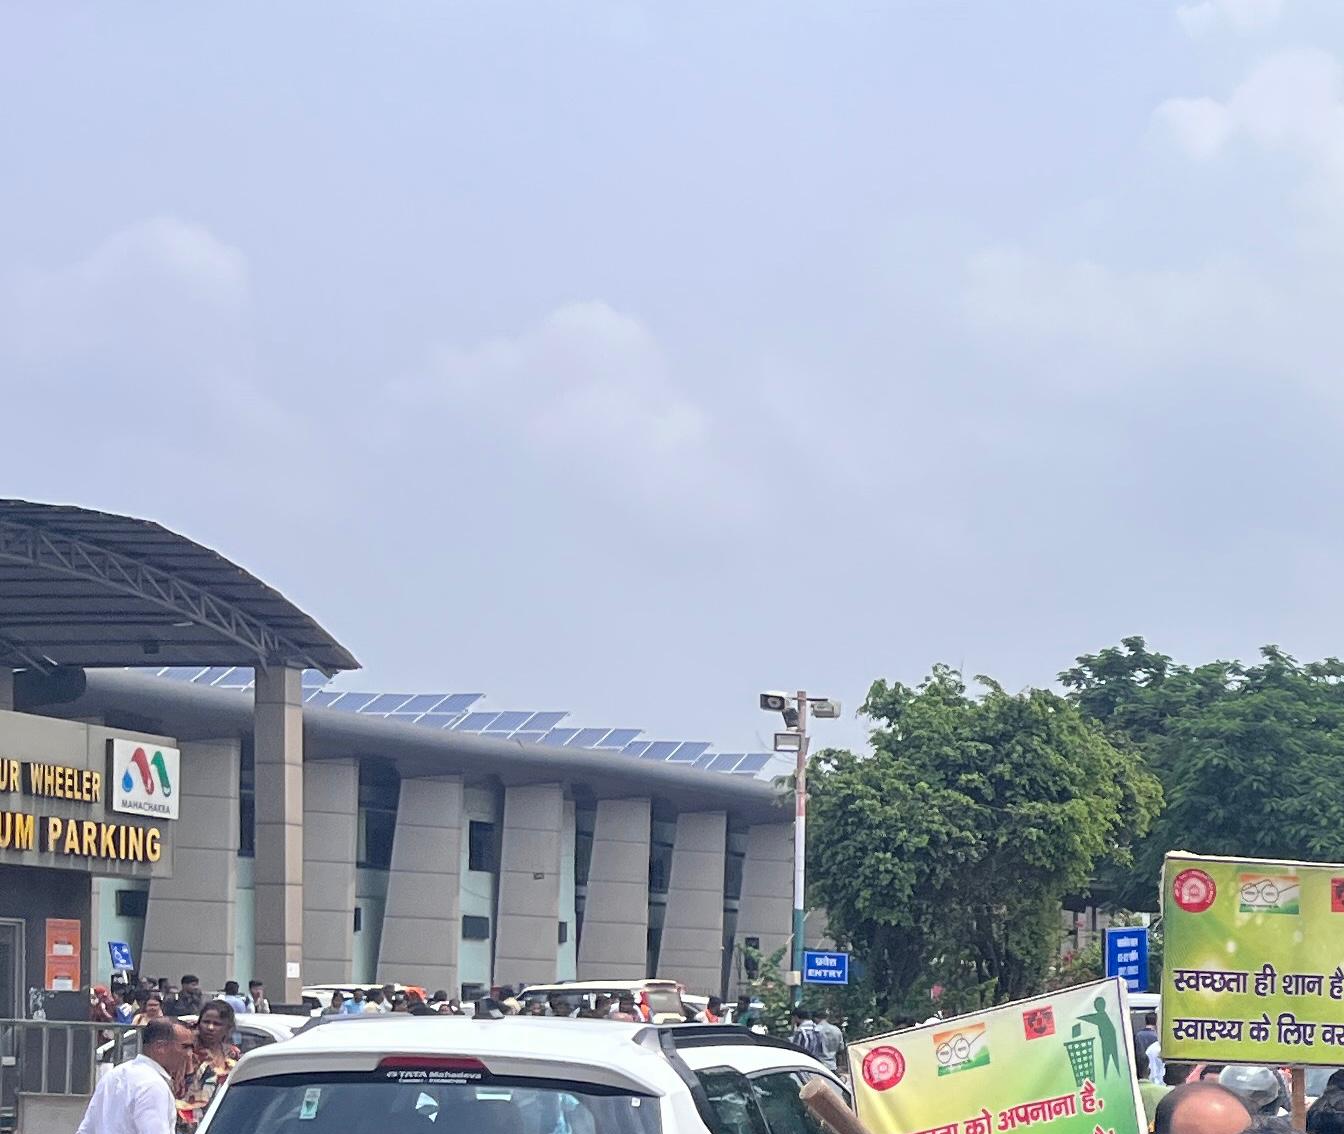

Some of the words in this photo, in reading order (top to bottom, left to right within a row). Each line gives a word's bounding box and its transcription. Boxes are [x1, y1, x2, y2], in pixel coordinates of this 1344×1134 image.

[31, 762, 100, 802] WHEELER
[48, 816, 161, 862] PARKING
[808, 968, 843, 978] ENTRY
[1173, 970, 1248, 993] स्वच्छता
[1254, 964, 1277, 997] ही
[1283, 974, 1324, 996] शान
[1172, 1018, 1243, 1042] स्वास्थ्य
[1249, 1013, 1271, 1042] के
[1277, 1013, 1316, 1045] लिए
[399, 1070, 427, 1078] TATA
[998, 1094, 1075, 1131] अपनाना
[1080, 1080, 1104, 1114] है,
